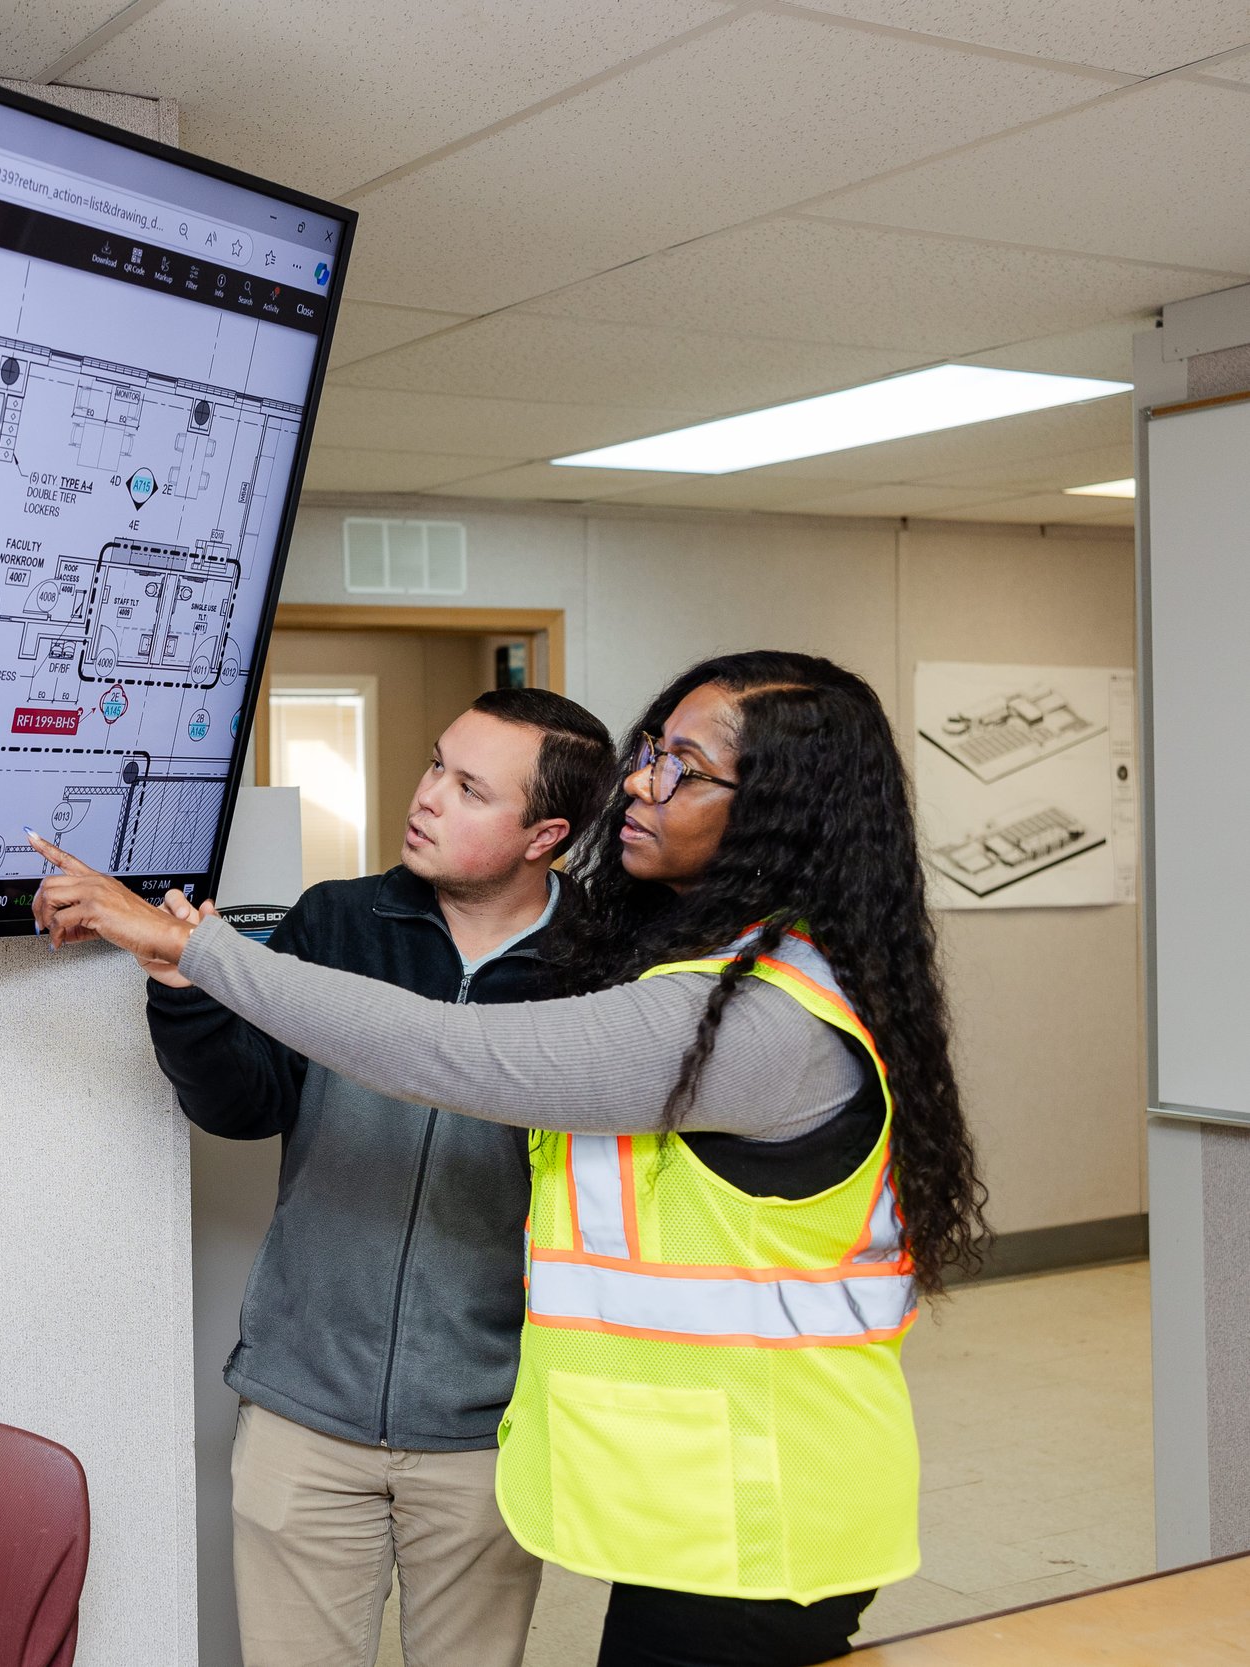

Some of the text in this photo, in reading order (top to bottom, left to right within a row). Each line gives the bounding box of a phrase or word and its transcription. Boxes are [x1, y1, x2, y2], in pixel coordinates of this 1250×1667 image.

[91, 253, 118, 269] Download
[123, 263, 146, 276] QR Code
[154, 272, 173, 285] Markup
[185, 279, 198, 291] Filter
[214, 288, 224, 298] Info
[237, 295, 253, 306] Search
[262, 302, 280, 315] Activity
[296, 303, 315, 318] Close
[115, 388, 140, 401] MONITOR
[86, 409, 95, 418] EQ
[119, 415, 127, 424] EQ
[29, 472, 40, 485] (5)
[61, 476, 79, 490] TYPE
[80, 480, 93, 492] A-4
[110, 475, 122, 487] 4D
[133, 479, 151, 493] A715
[27, 486, 77, 504] DOUBLE TIER
[162, 484, 173, 496] 2E
[24, 502, 60, 517] LOCKERS
[129, 520, 140, 531] 4E
[6, 538, 42, 552] FACULTY
[64, 564, 78, 572] ROOF
[9, 572, 26, 583] 4007
[59, 574, 80, 583] ACCESS
[39, 592, 56, 602] 4008
[114, 597, 139, 607] STAFF TLT
[191, 603, 208, 612] SINGLE
[49, 662, 71, 673] DF/BF
[98, 657, 112, 668] 4009
[193, 665, 207, 675] 4011
[222, 668, 236, 677] 4012
[38, 691, 46, 699] EQ
[62, 692, 70, 700] EQ
[110, 692, 120, 702] 2E
[104, 706, 121, 717] A145
[16, 714, 76, 729] RFI 199-BHS
[196, 713, 205, 723] 2B
[190, 727, 205, 736] A145
[54, 812, 70, 821] 4013
[142, 880, 171, 890] 9:57 AM
[13, 894, 35, 906] +0.2
[221, 912, 265, 923] ANKERS
